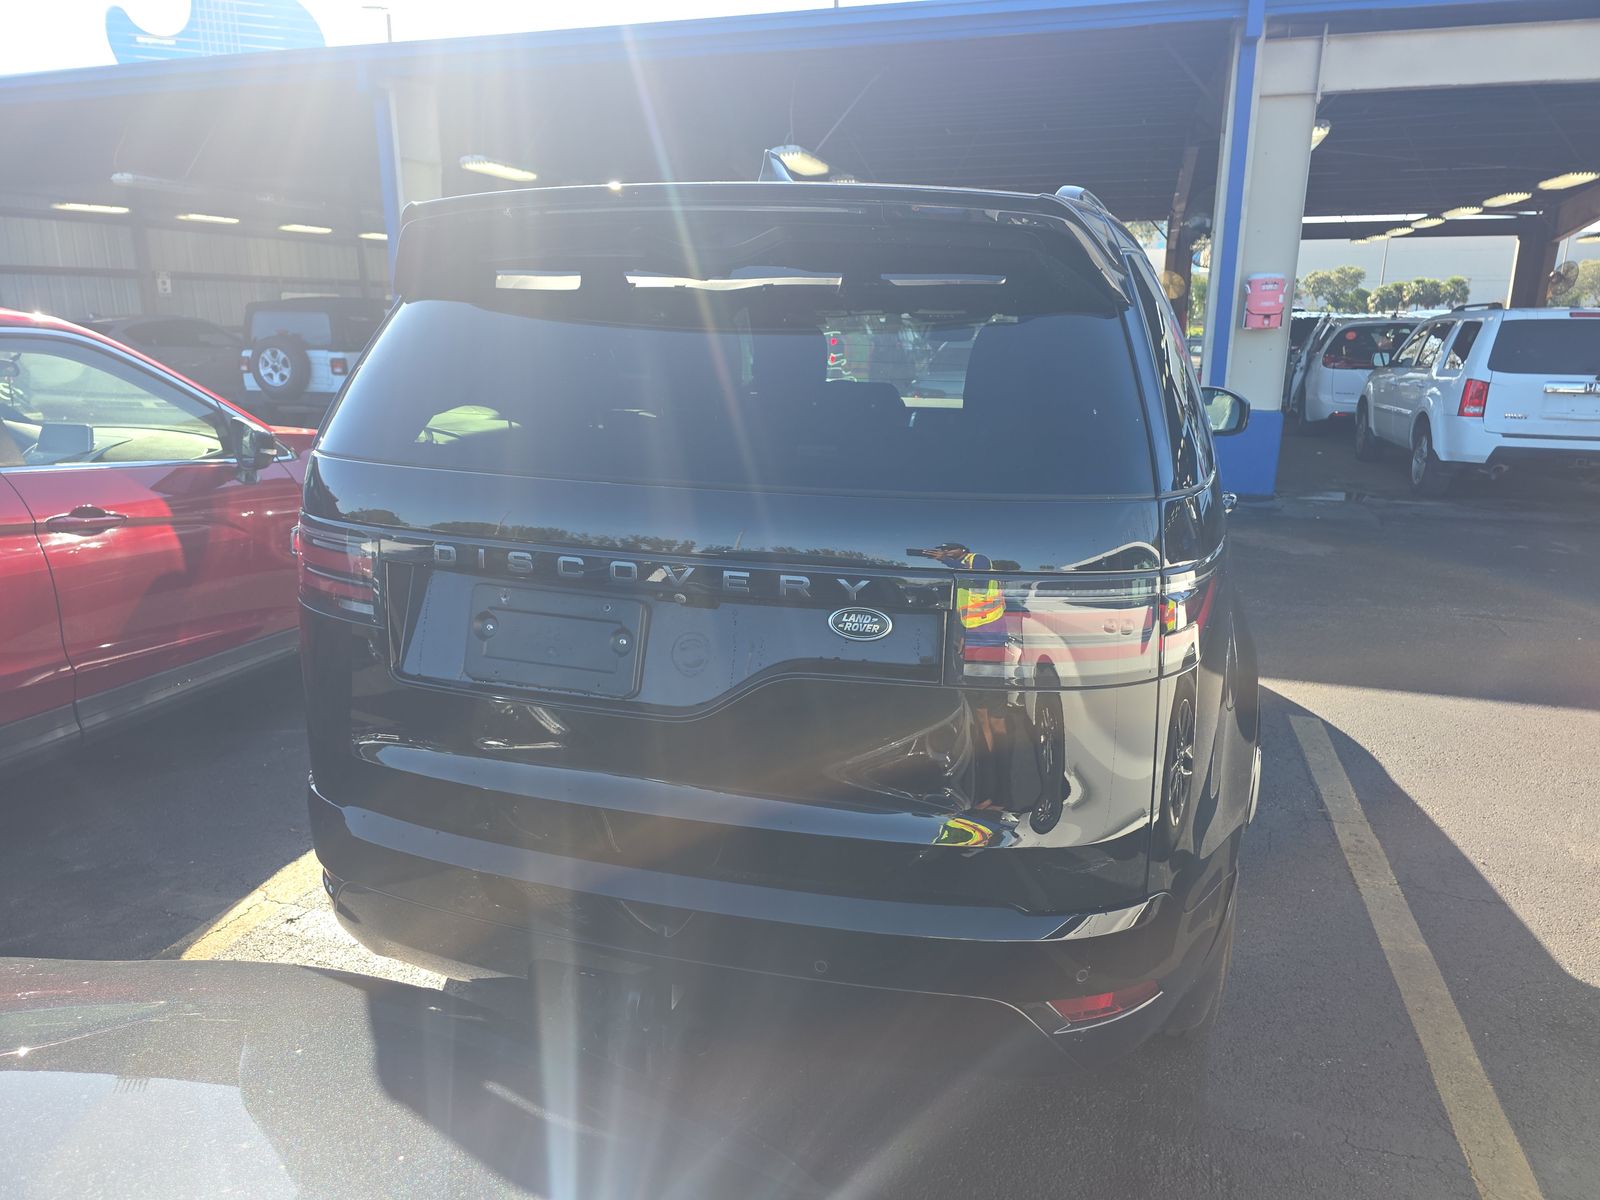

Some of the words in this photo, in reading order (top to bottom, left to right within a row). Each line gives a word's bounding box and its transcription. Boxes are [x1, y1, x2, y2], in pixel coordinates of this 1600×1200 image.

[433, 544, 871, 600] DISCOVERY
[842, 613, 872, 624] LAND
[844, 622, 880, 633] ROVER
